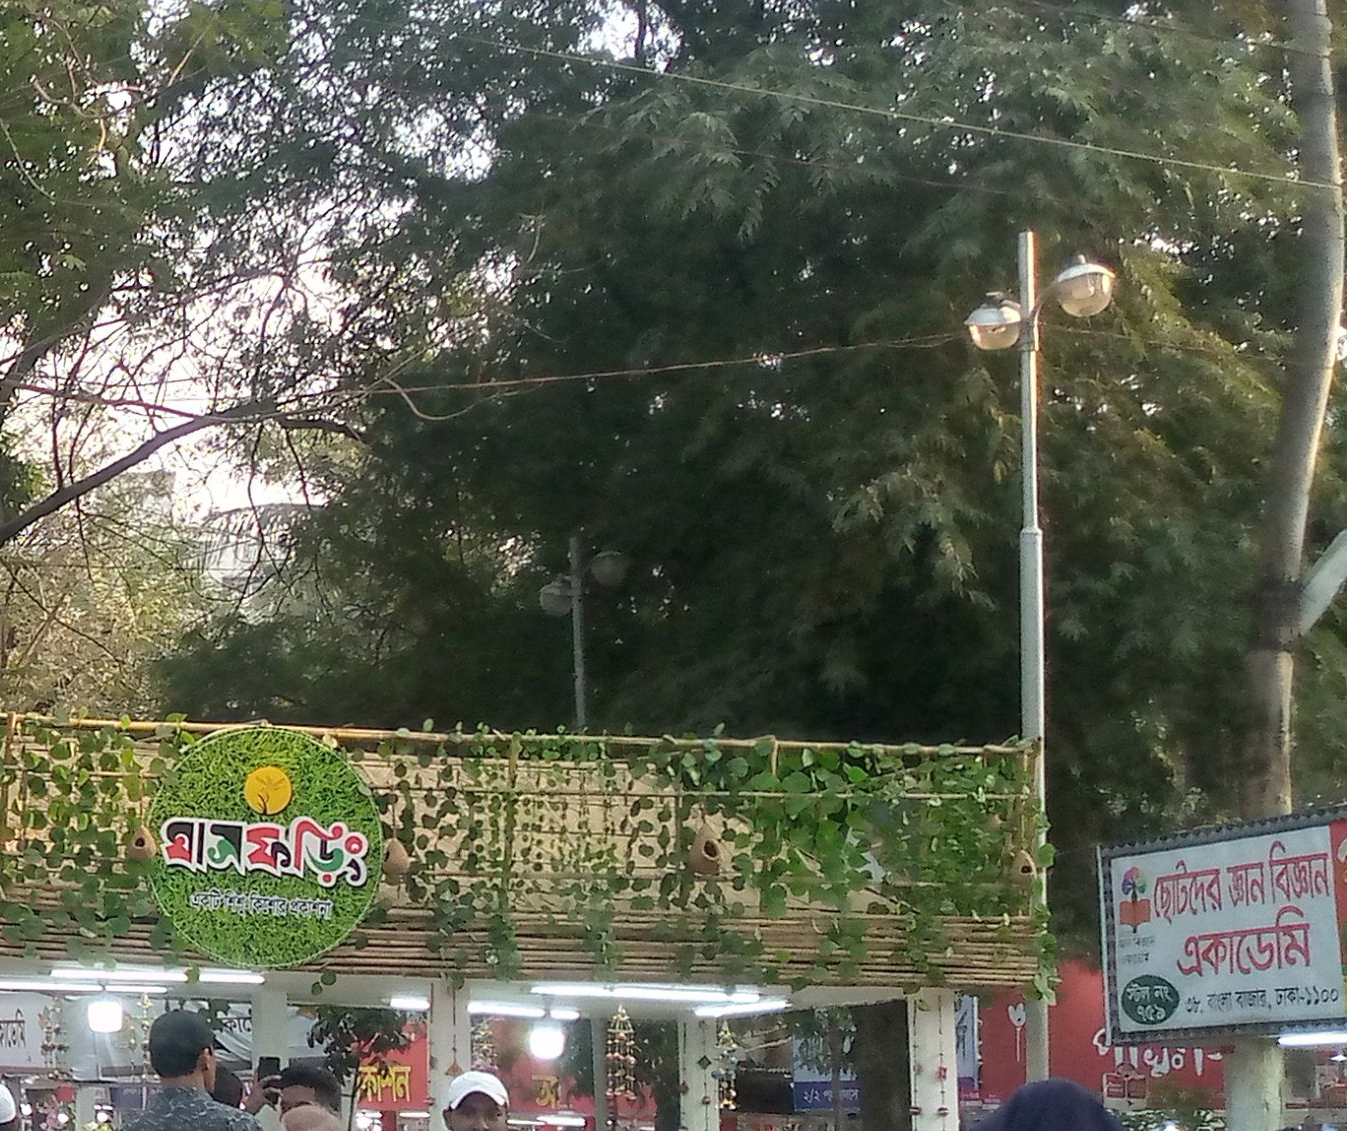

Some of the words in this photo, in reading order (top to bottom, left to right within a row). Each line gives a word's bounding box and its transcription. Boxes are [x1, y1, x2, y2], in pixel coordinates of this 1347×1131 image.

[161, 816, 368, 888] ঘাসফড়িং
[1154, 860, 1222, 924] ছোটদের
[1226, 861, 1266, 907] জ্ঞান
[1270, 840, 1330, 904] বিজ্ঞান
[191, 887, 221, 911] একটি
[288, 898, 333, 920] প্রকাশনা
[1177, 905, 1310, 977] একাডেমি
